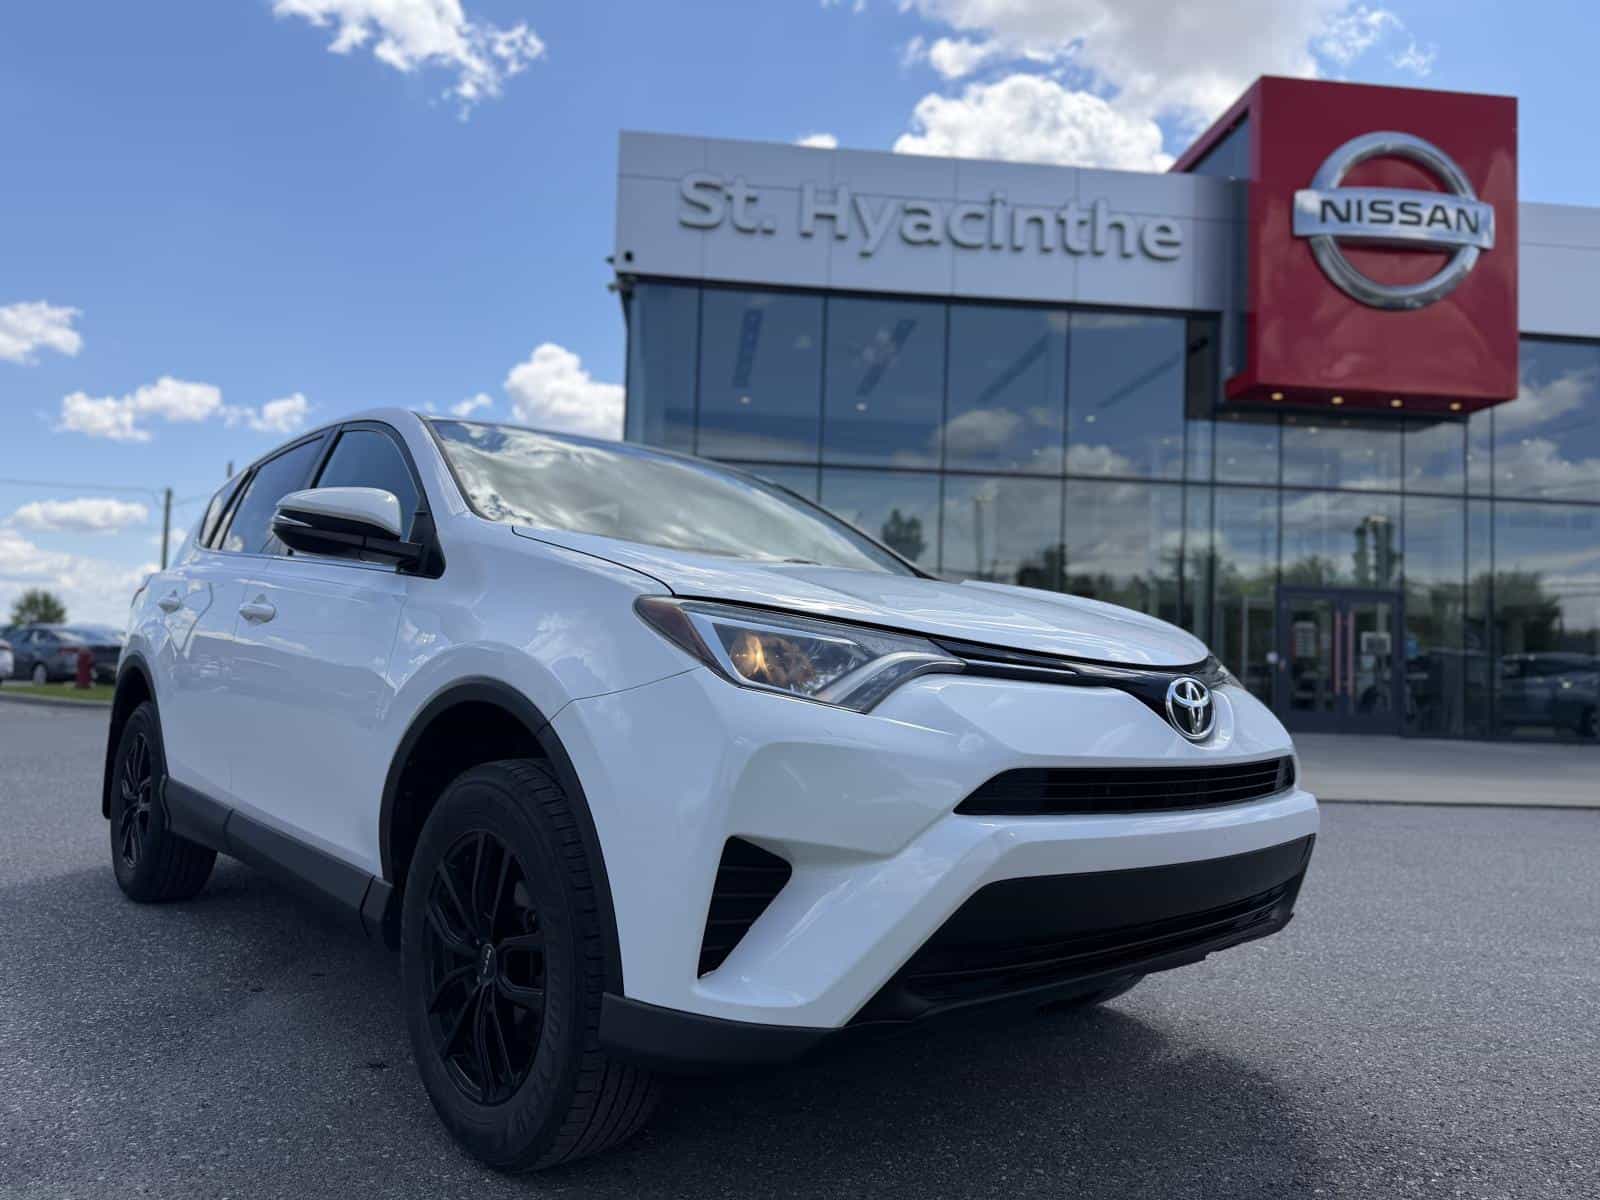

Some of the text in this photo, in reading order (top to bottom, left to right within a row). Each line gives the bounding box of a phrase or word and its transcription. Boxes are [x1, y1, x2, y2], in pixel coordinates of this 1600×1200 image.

[678, 171, 1184, 262] St. Hyacinthe
[1320, 199, 1480, 234] NISSAN
